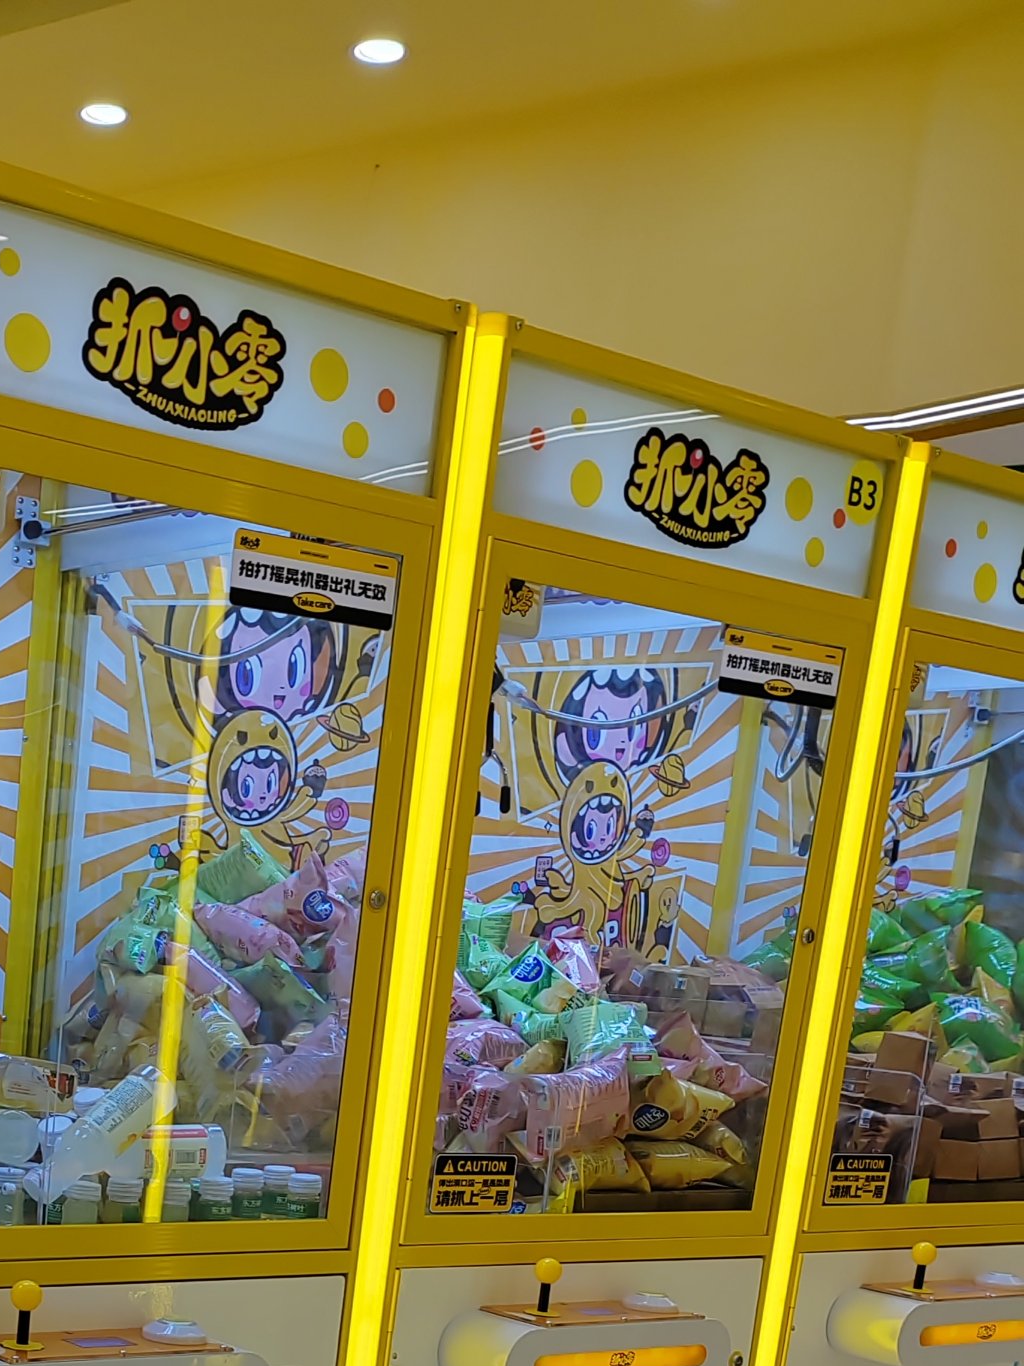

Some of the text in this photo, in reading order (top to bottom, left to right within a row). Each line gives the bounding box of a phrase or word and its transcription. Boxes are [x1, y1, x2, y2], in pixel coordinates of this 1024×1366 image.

[88, 287, 281, 414] 抓小零
[136, 386, 238, 423] ZHUAXIAOLING
[628, 435, 766, 534] 抓小零
[848, 476, 878, 511] B3
[239, 559, 387, 601] 拍打摇晃机器出礼无效
[297, 596, 332, 610] Take care
[727, 653, 833, 685] 拍打摇晃机器出礼无效
[457, 1160, 508, 1172] CAUTION
[847, 1159, 885, 1169] CAUTION
[435, 1190, 509, 1207] 请抓上一层
